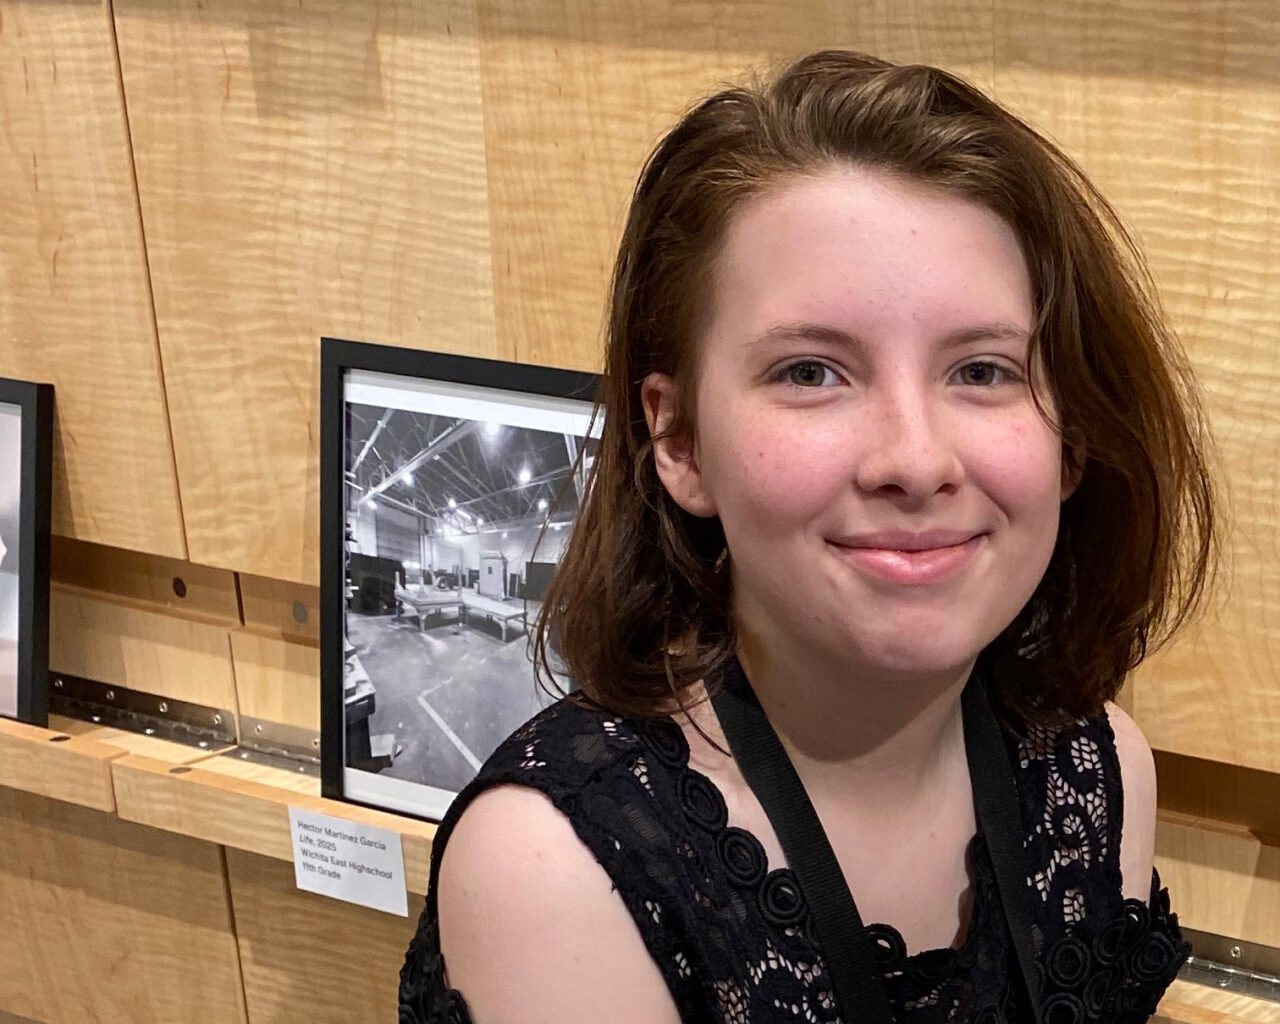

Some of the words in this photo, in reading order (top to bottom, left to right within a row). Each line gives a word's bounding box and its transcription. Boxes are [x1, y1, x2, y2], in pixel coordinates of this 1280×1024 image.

[297, 820, 323, 834] Hector
[324, 827, 358, 844] Martinez
[360, 836, 386, 851] Garcia
[299, 834, 316, 847] Life,
[317, 839, 337, 852] 2025
[301, 848, 329, 863] Wichita
[330, 856, 347, 868] East
[349, 861, 393, 880] Highschool
[318, 866, 342, 880] Grade
